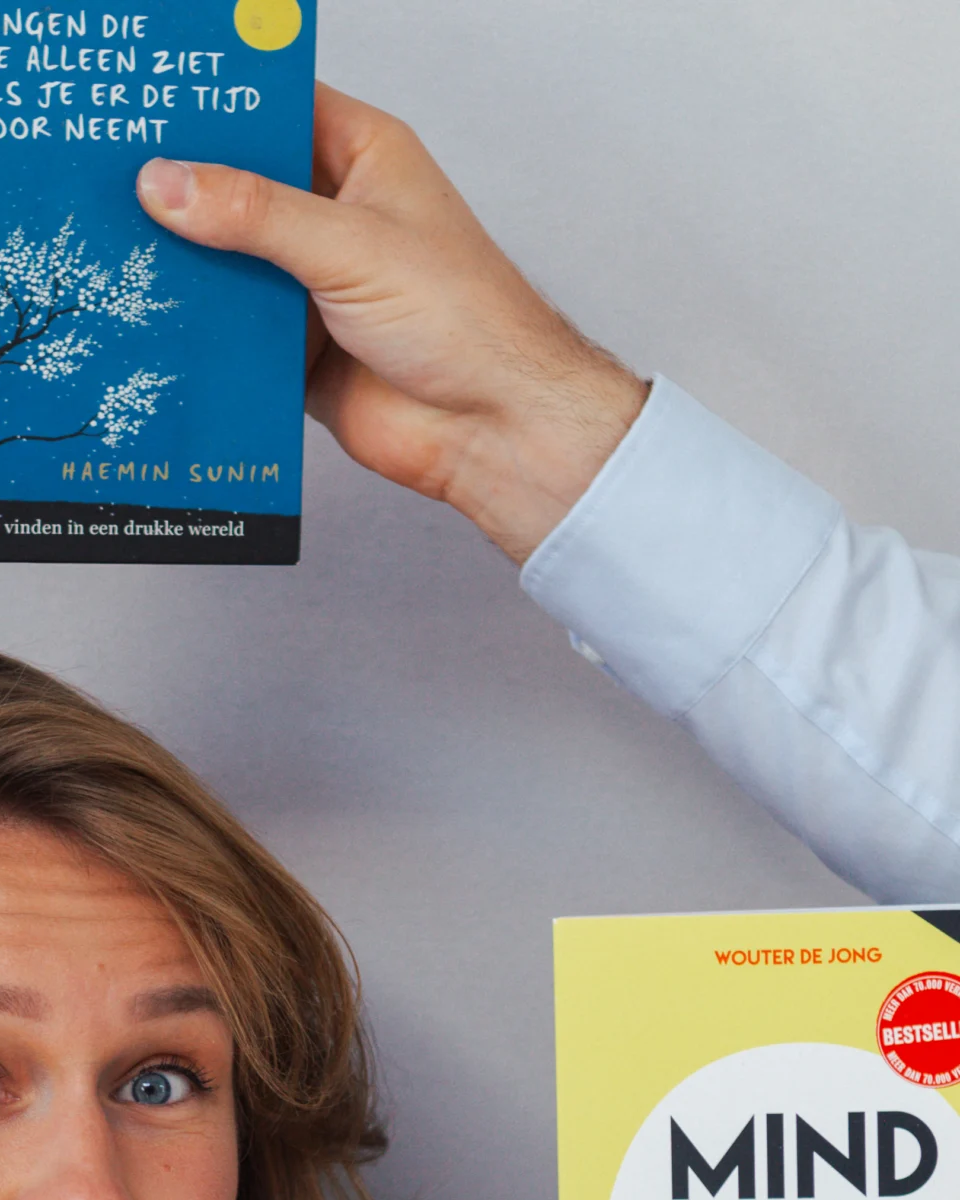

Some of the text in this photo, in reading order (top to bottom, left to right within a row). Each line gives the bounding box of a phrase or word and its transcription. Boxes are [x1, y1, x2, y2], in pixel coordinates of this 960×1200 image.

[102, 14, 149, 39] DIE
[26, 45, 136, 74] ALLEEN
[152, 51, 225, 76] ZIET
[38, 81, 76, 109] JE
[91, 83, 130, 107] ER
[144, 84, 179, 108] DE
[192, 86, 261, 114] TIJD
[65, 118, 169, 144] NEEMT
[61, 461, 281, 483] HAEMIN SUNIM
[4, 520, 62, 536] vinden
[67, 521, 85, 536] in
[89, 524, 119, 536] een
[123, 520, 184, 537] drukke
[187, 520, 245, 537] wereld
[714, 947, 882, 966] WOUTER DE JONG
[896, 987, 914, 1002] DAN
[913, 979, 943, 992] 70.000
[882, 1021, 960, 1046] BESTSELL
[904, 1067, 921, 1082] DAN
[923, 1072, 951, 1085] 70.000
[670, 1110, 939, 1200] MIND
